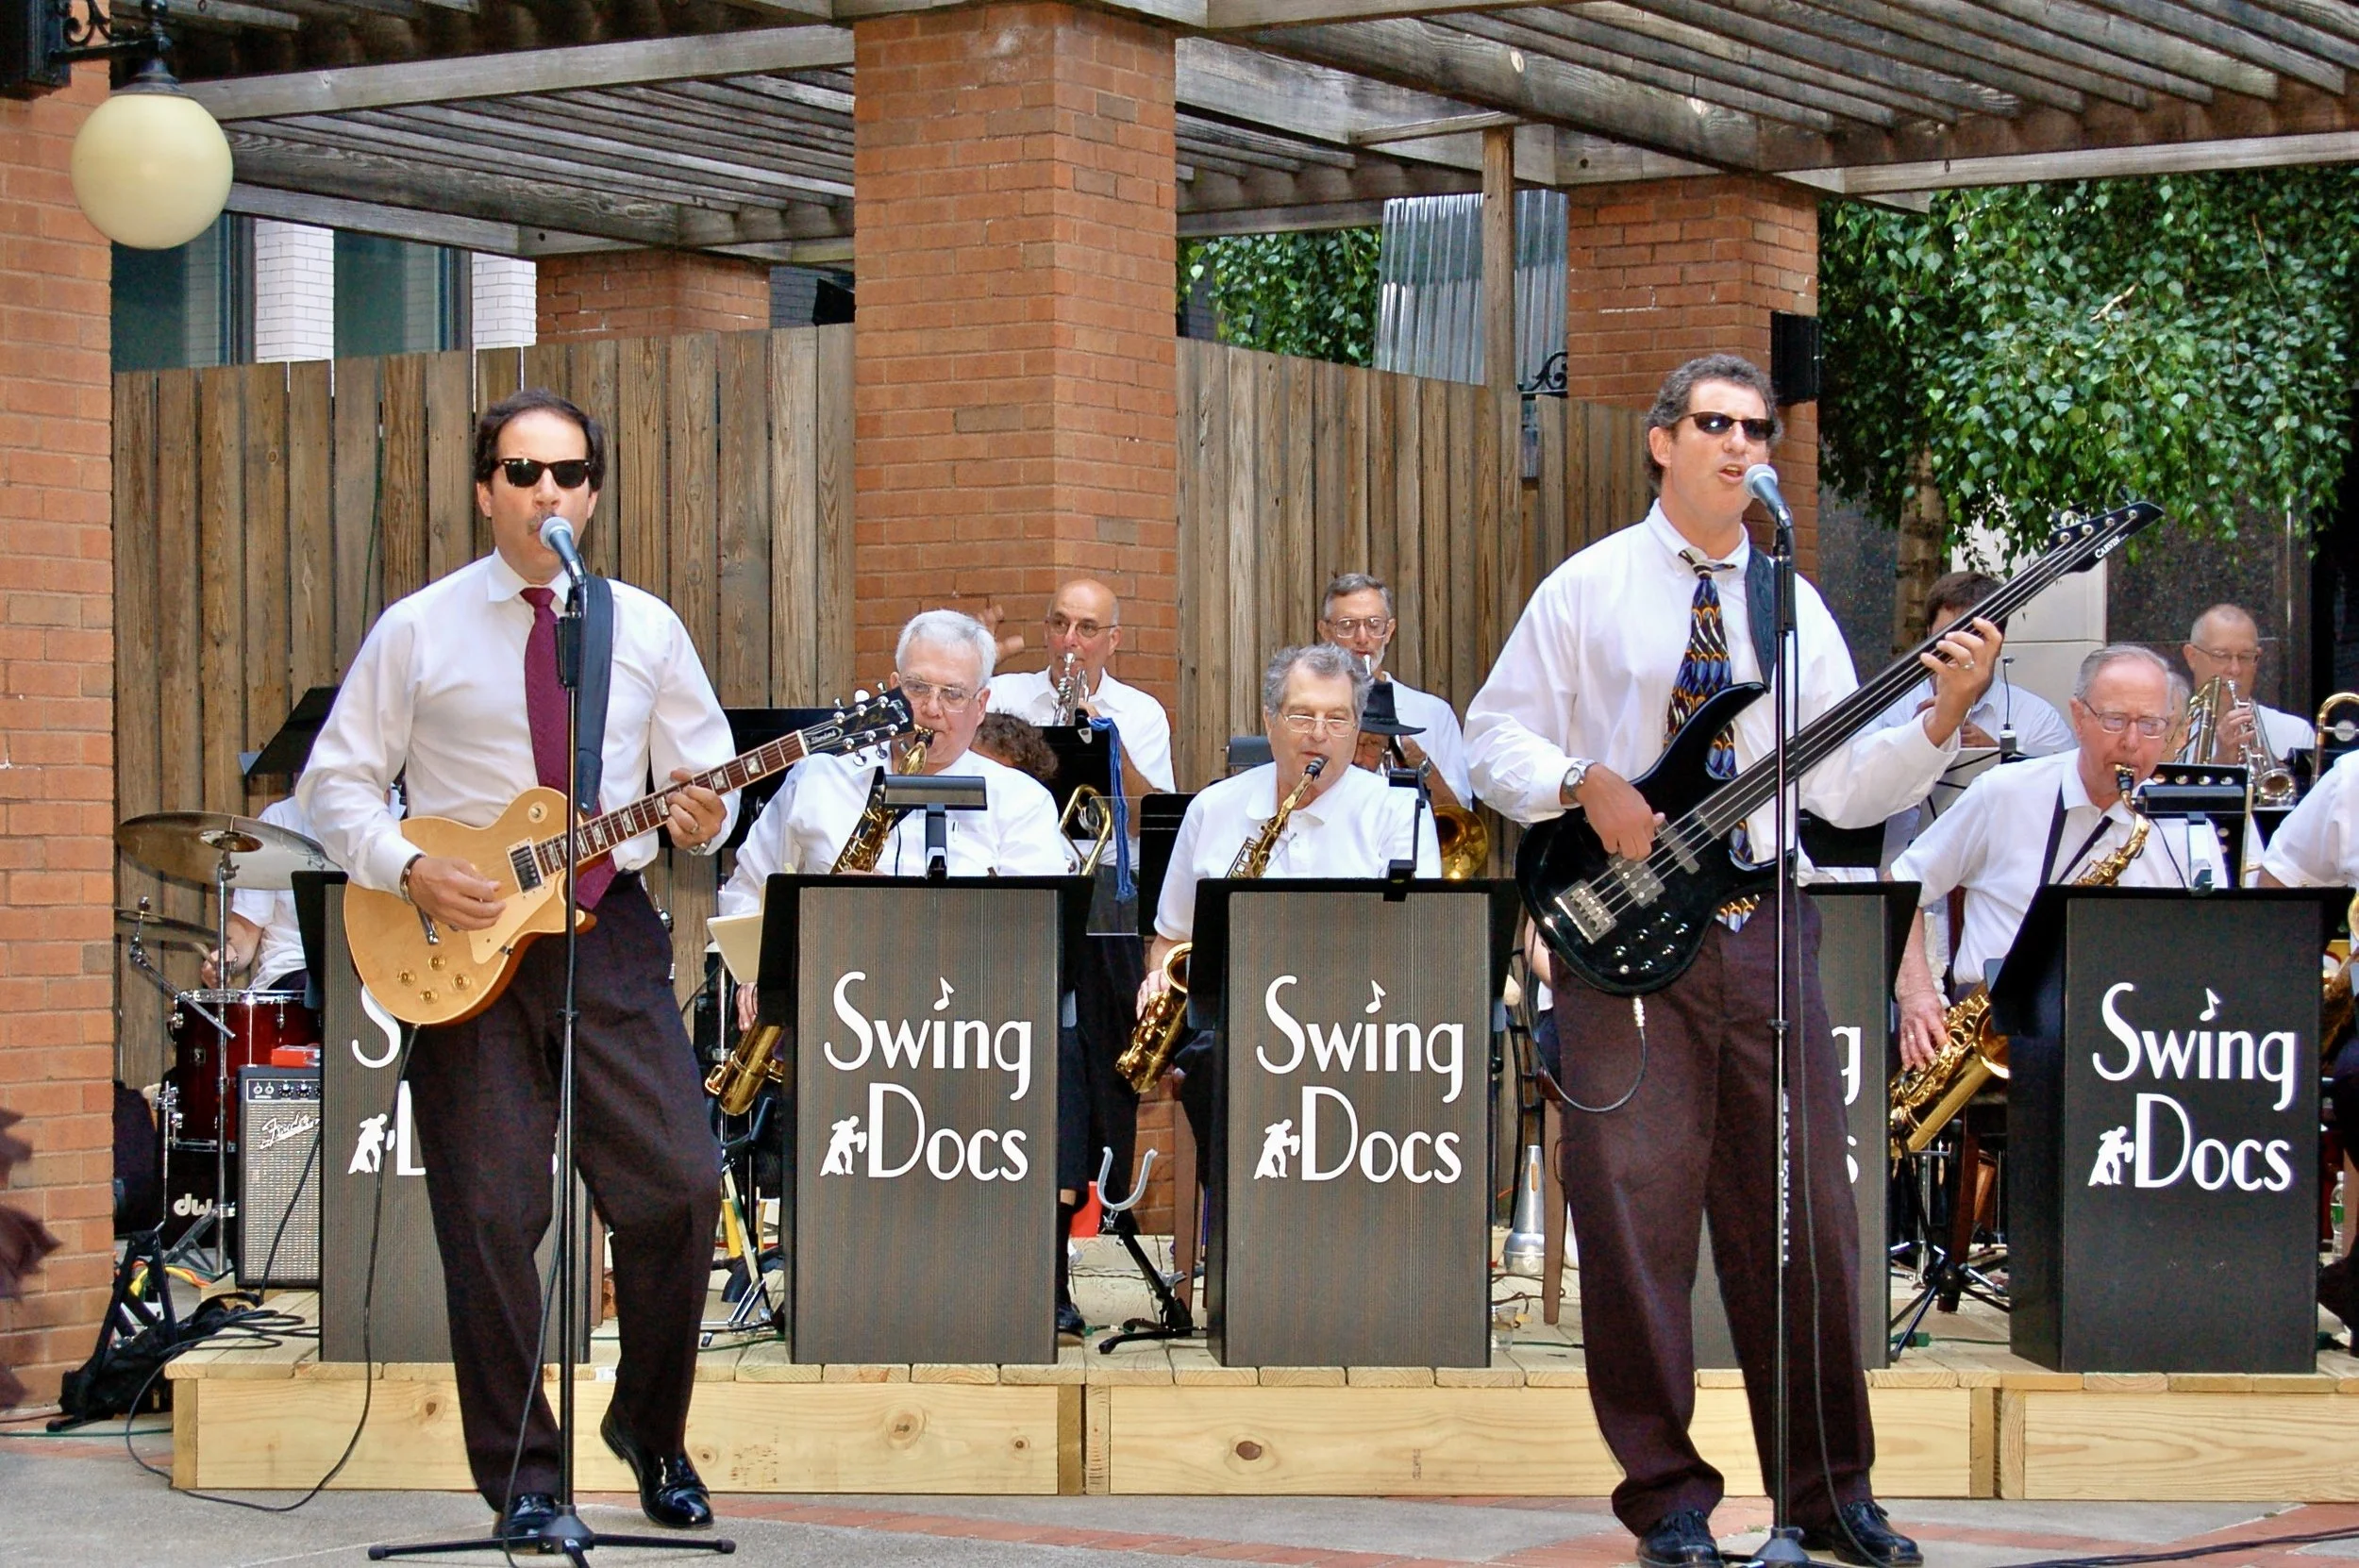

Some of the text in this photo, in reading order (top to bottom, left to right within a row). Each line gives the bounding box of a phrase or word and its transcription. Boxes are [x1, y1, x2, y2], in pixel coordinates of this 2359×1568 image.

[823, 971, 1032, 1101] Swing
[1256, 975, 1464, 1104] Swing
[2092, 982, 2296, 1111] Swing
[867, 1082, 1029, 1182] Docs
[1301, 1085, 1463, 1184] Docs
[2134, 1093, 2292, 1192] Docs
[174, 1193, 212, 1216] dw
